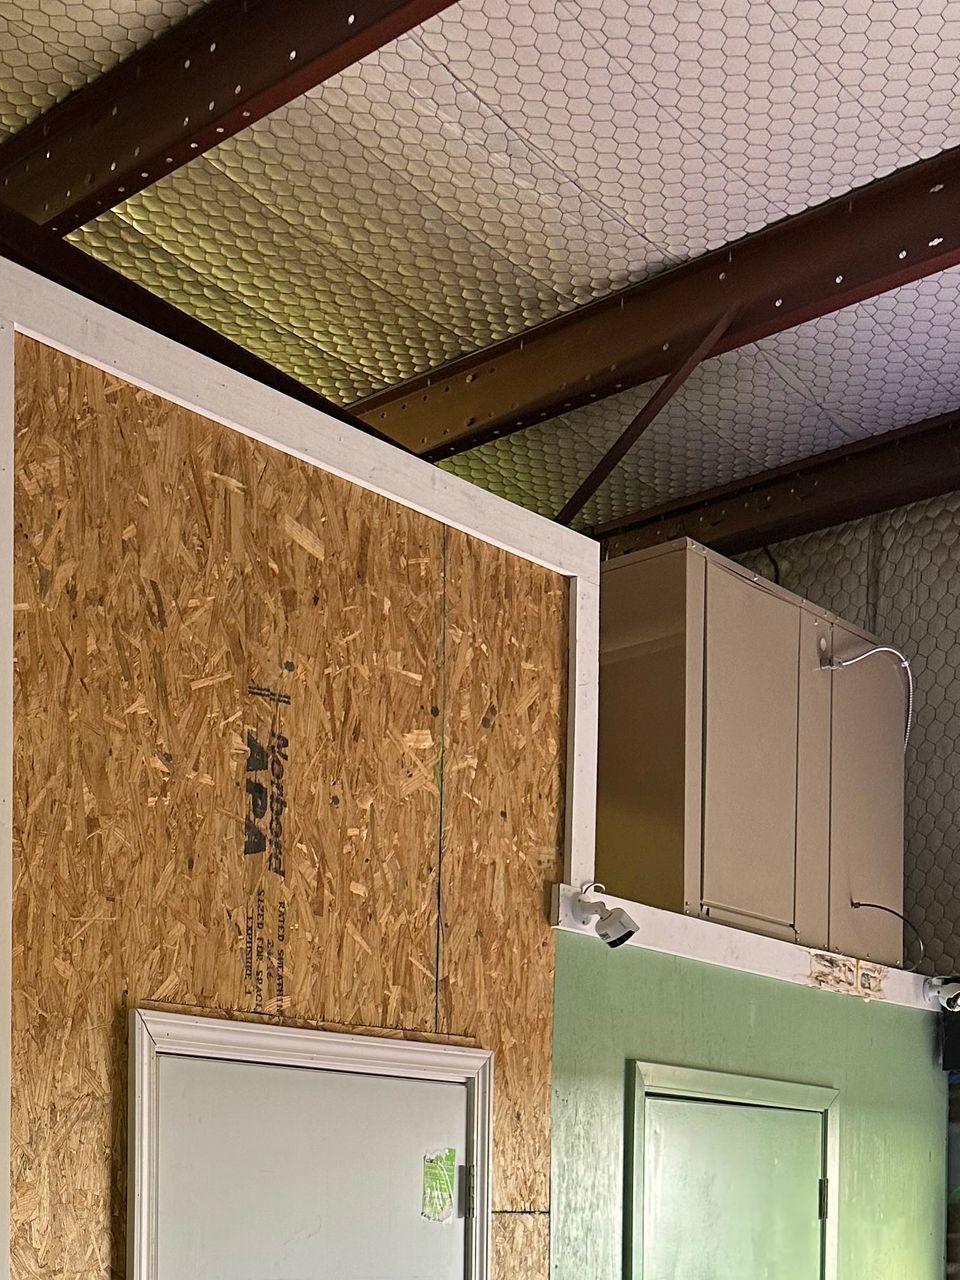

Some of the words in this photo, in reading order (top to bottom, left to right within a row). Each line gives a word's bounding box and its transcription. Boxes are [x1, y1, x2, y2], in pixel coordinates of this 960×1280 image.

[244, 729, 268, 856] APA
[268, 733, 289, 878] Norbord
[256, 889, 265, 930] SIZED
[277, 899, 286, 942] RATED
[255, 937, 264, 961] FOR
